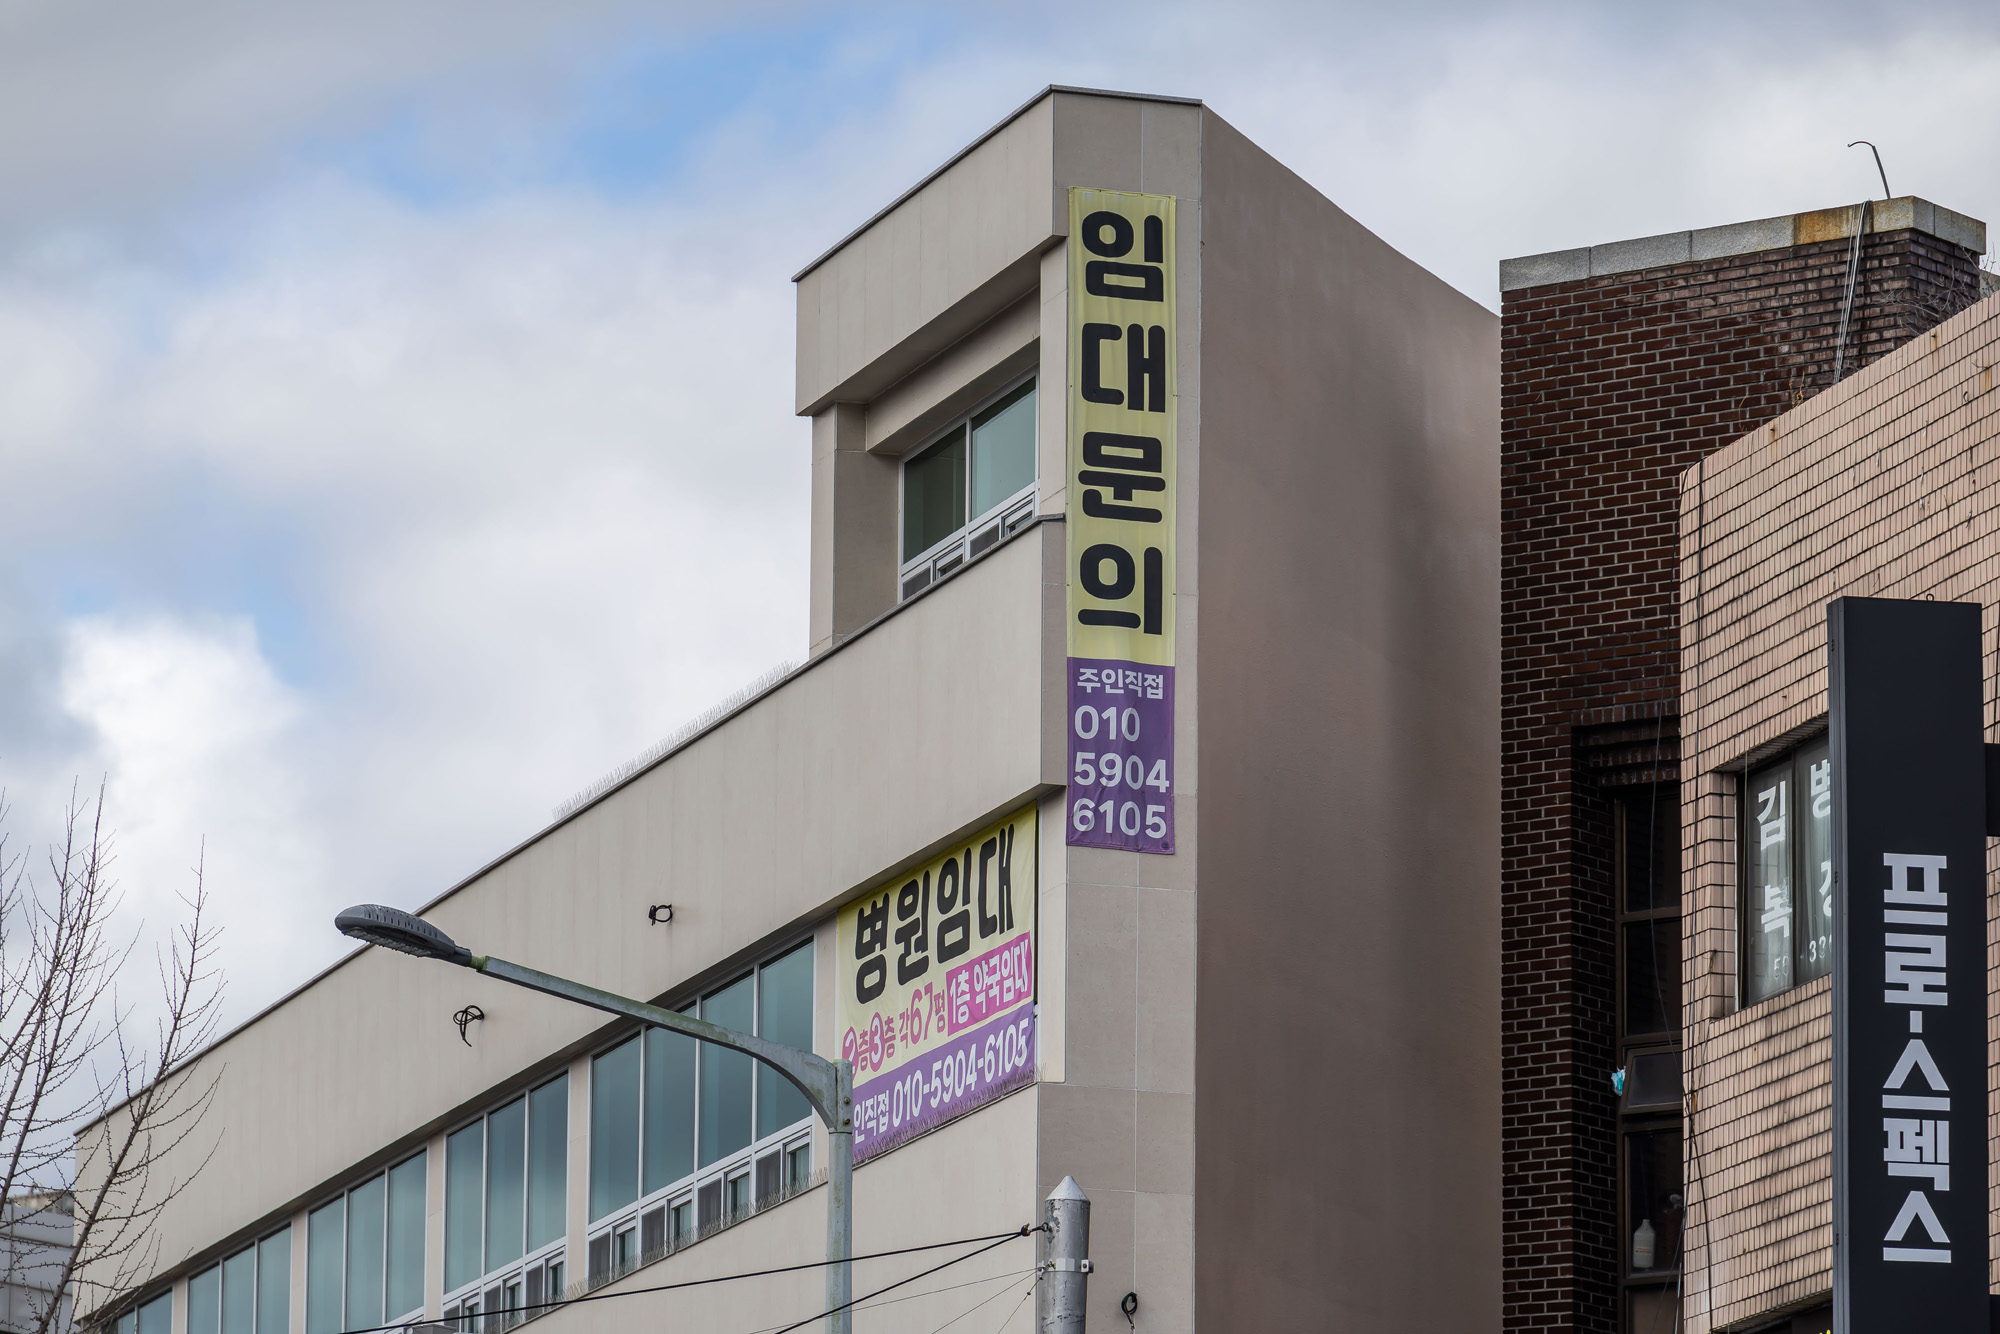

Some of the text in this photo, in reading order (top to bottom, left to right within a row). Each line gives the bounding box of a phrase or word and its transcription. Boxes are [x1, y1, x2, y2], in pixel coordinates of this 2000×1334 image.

[1078, 211, 1166, 635] 임대문의
[1077, 668, 1164, 700] 주인직접
[1074, 705, 1141, 742] 010
[1073, 752, 1170, 793] 5904
[1072, 798, 1167, 839] 6105
[855, 823, 1015, 1005] 병원임대
[851, 1017, 1029, 1145] 인직접 010-5904-6105
